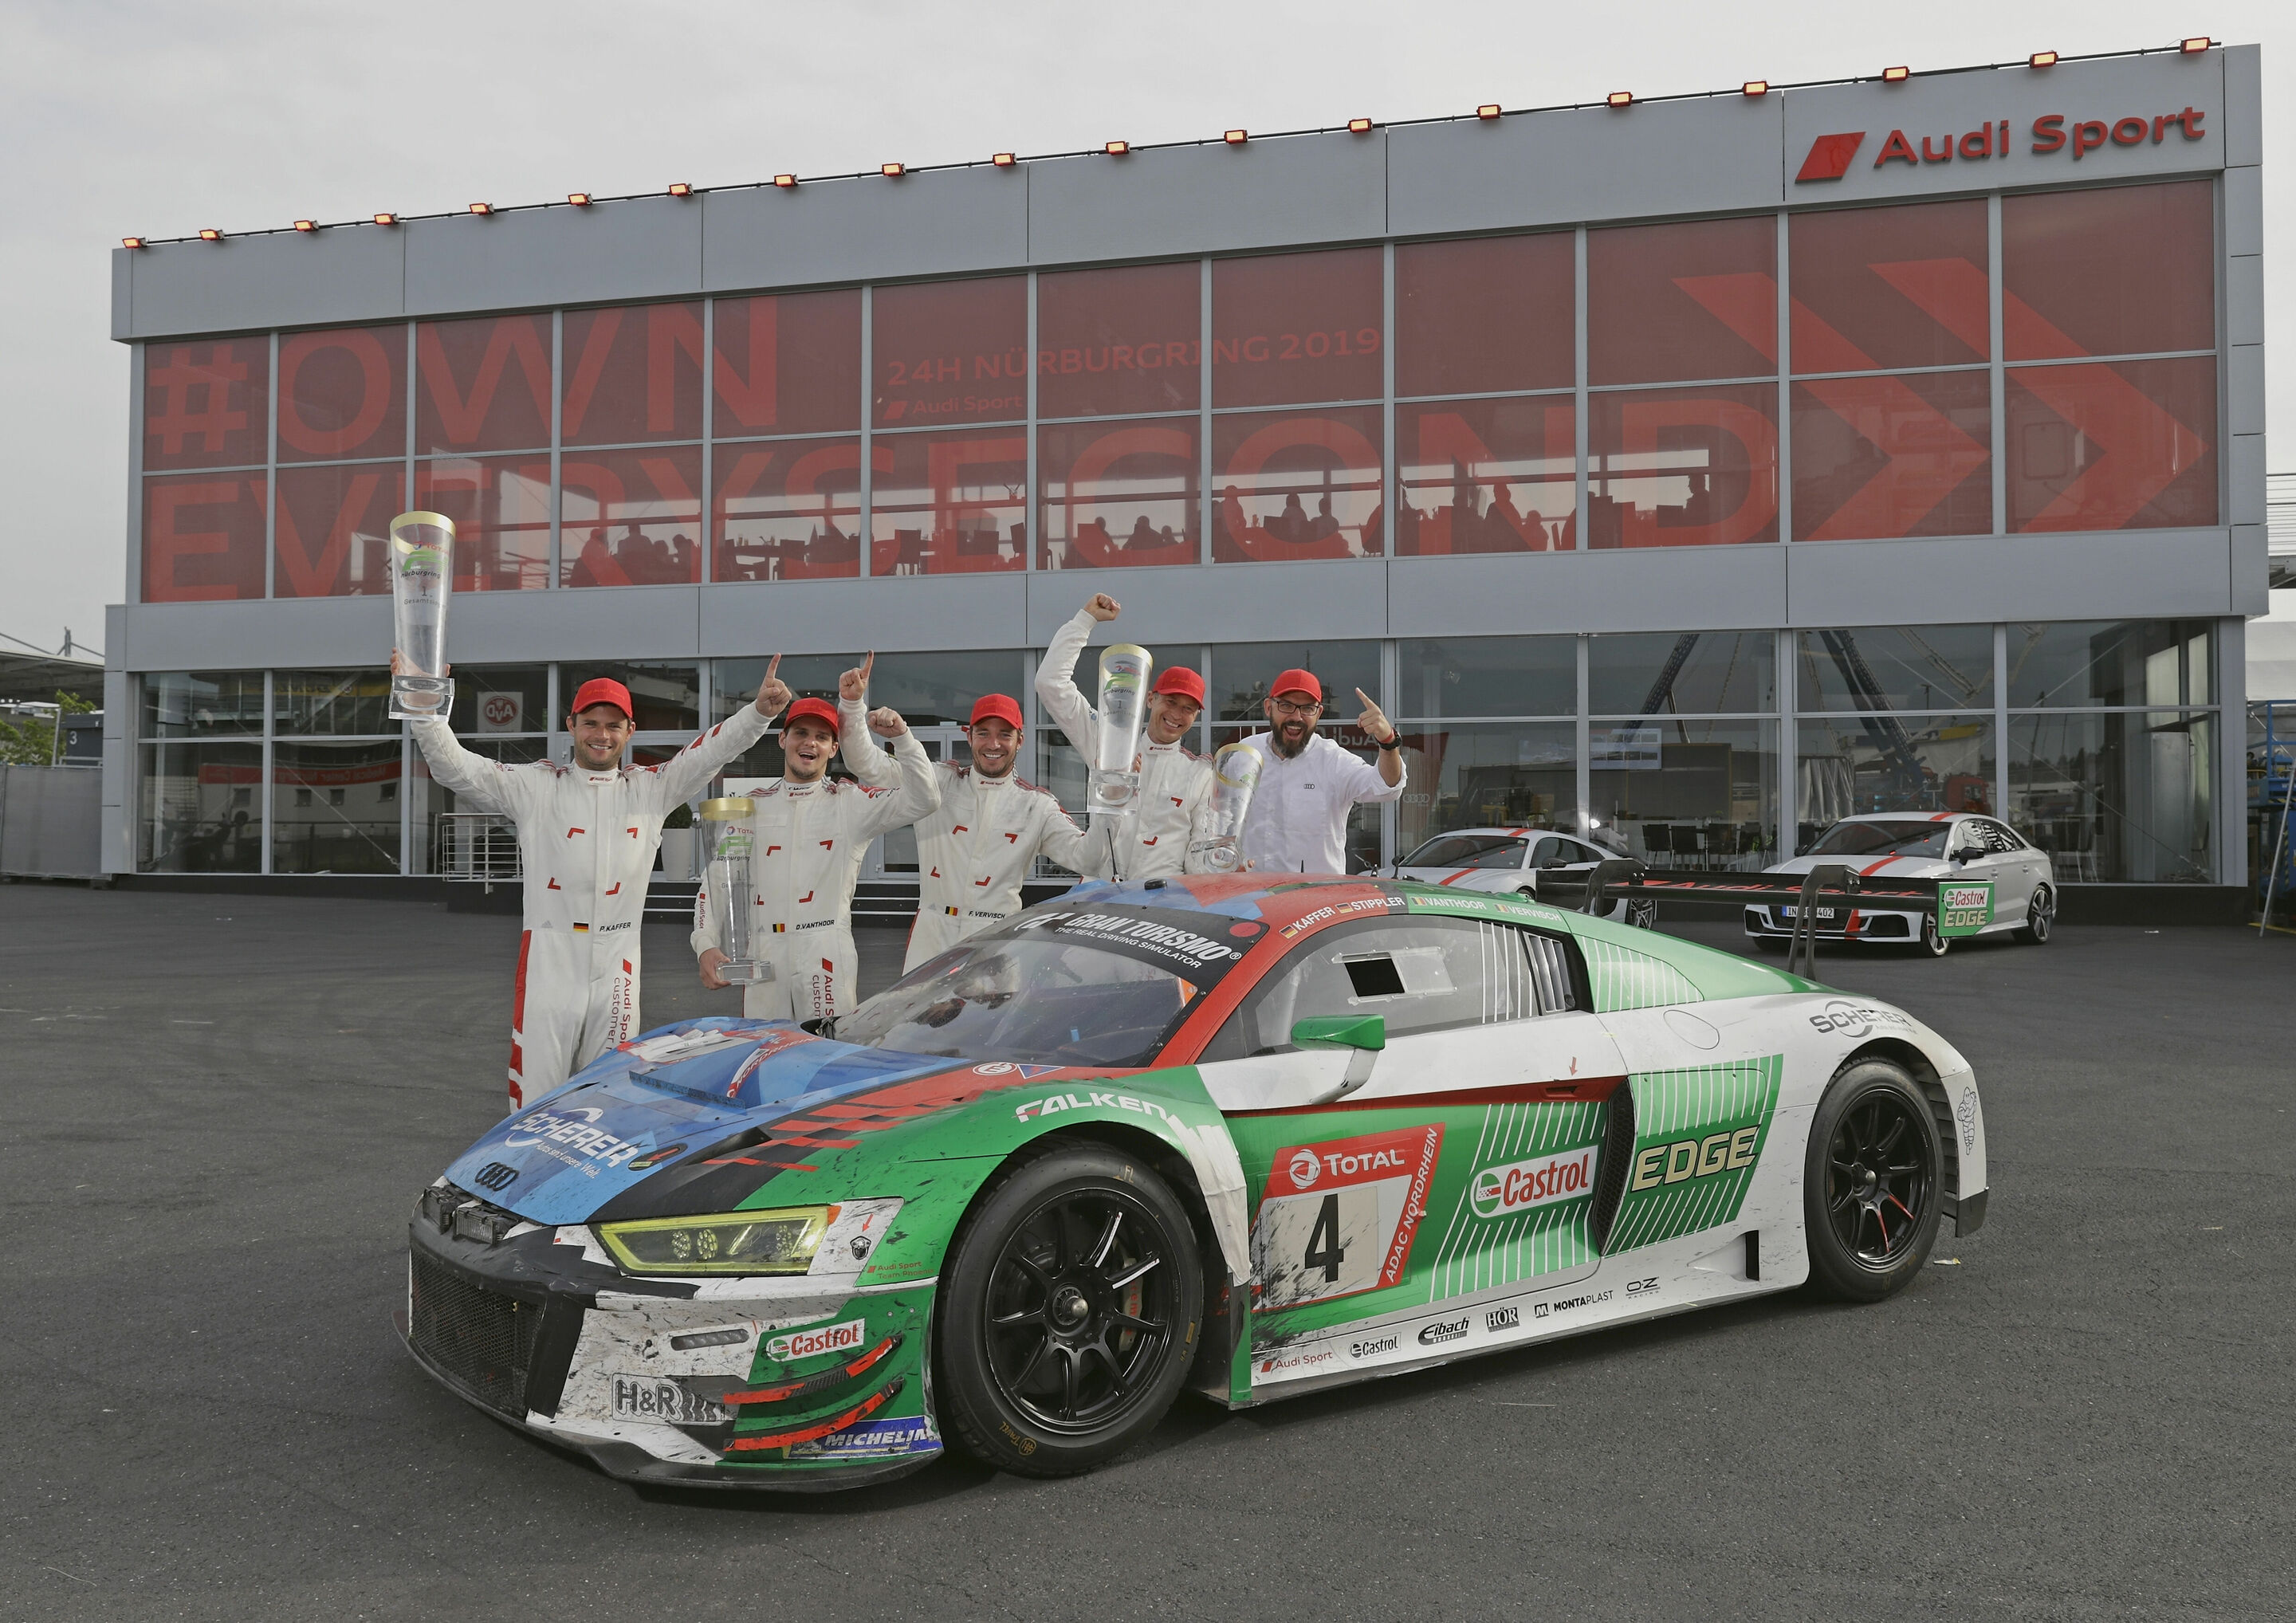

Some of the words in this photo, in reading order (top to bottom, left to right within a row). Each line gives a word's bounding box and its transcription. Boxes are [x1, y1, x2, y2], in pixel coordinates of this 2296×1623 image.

[1874, 119, 2010, 168] Audi
[2031, 106, 2206, 159] Sport
[886, 356, 962, 387] 24H
[974, 335, 1270, 380] NÜRBURGRING
[1278, 327, 1382, 362] 2019
[147, 296, 777, 455] #OWN
[912, 398, 959, 415] Audi
[963, 394, 1024, 415] Sport
[69, 730, 77, 745] 3
[1350, 897, 1406, 911] STIPPLER
[1425, 897, 1487, 910] VANTHOOR
[1955, 890, 1987, 906] Castrol
[1063, 914, 1128, 935] GRAN
[1292, 906, 1335, 932] KAFFER
[1507, 905, 1562, 922] VERVISCH
[1944, 910, 1989, 928] EDGE
[1054, 926, 1070, 935] THE
[1070, 928, 1097, 939] REAL
[1097, 932, 1138, 947] DRIVING
[1138, 941, 1202, 969] SIMULATOR
[824, 974, 835, 1004] Audi
[1015, 1092, 1167, 1123] FALKEN
[510, 1112, 639, 1168] SCHERER
[1323, 1149, 1405, 1177] TOTAL
[1630, 1124, 1760, 1193] EDGE
[1504, 1153, 1590, 1207] Castrol
[1386, 1231, 1410, 1283] ADAC
[1403, 1126, 1439, 1230] NORDRHEIN
[1304, 1193, 1344, 1283] 4
[898, 1261, 922, 1270] Sport
[1554, 1290, 1614, 1312] MONTAPLAST
[1487, 1307, 1519, 1328] HÖR
[791, 1323, 859, 1356] Castrol
[1417, 1317, 1469, 1346] Eibach
[1276, 1358, 1300, 1369] Audi
[1303, 1350, 1333, 1365] Sport
[1362, 1336, 1398, 1356] Castrol
[615, 1379, 679, 1417] H&R
[824, 1429, 927, 1447] MICHELIN
